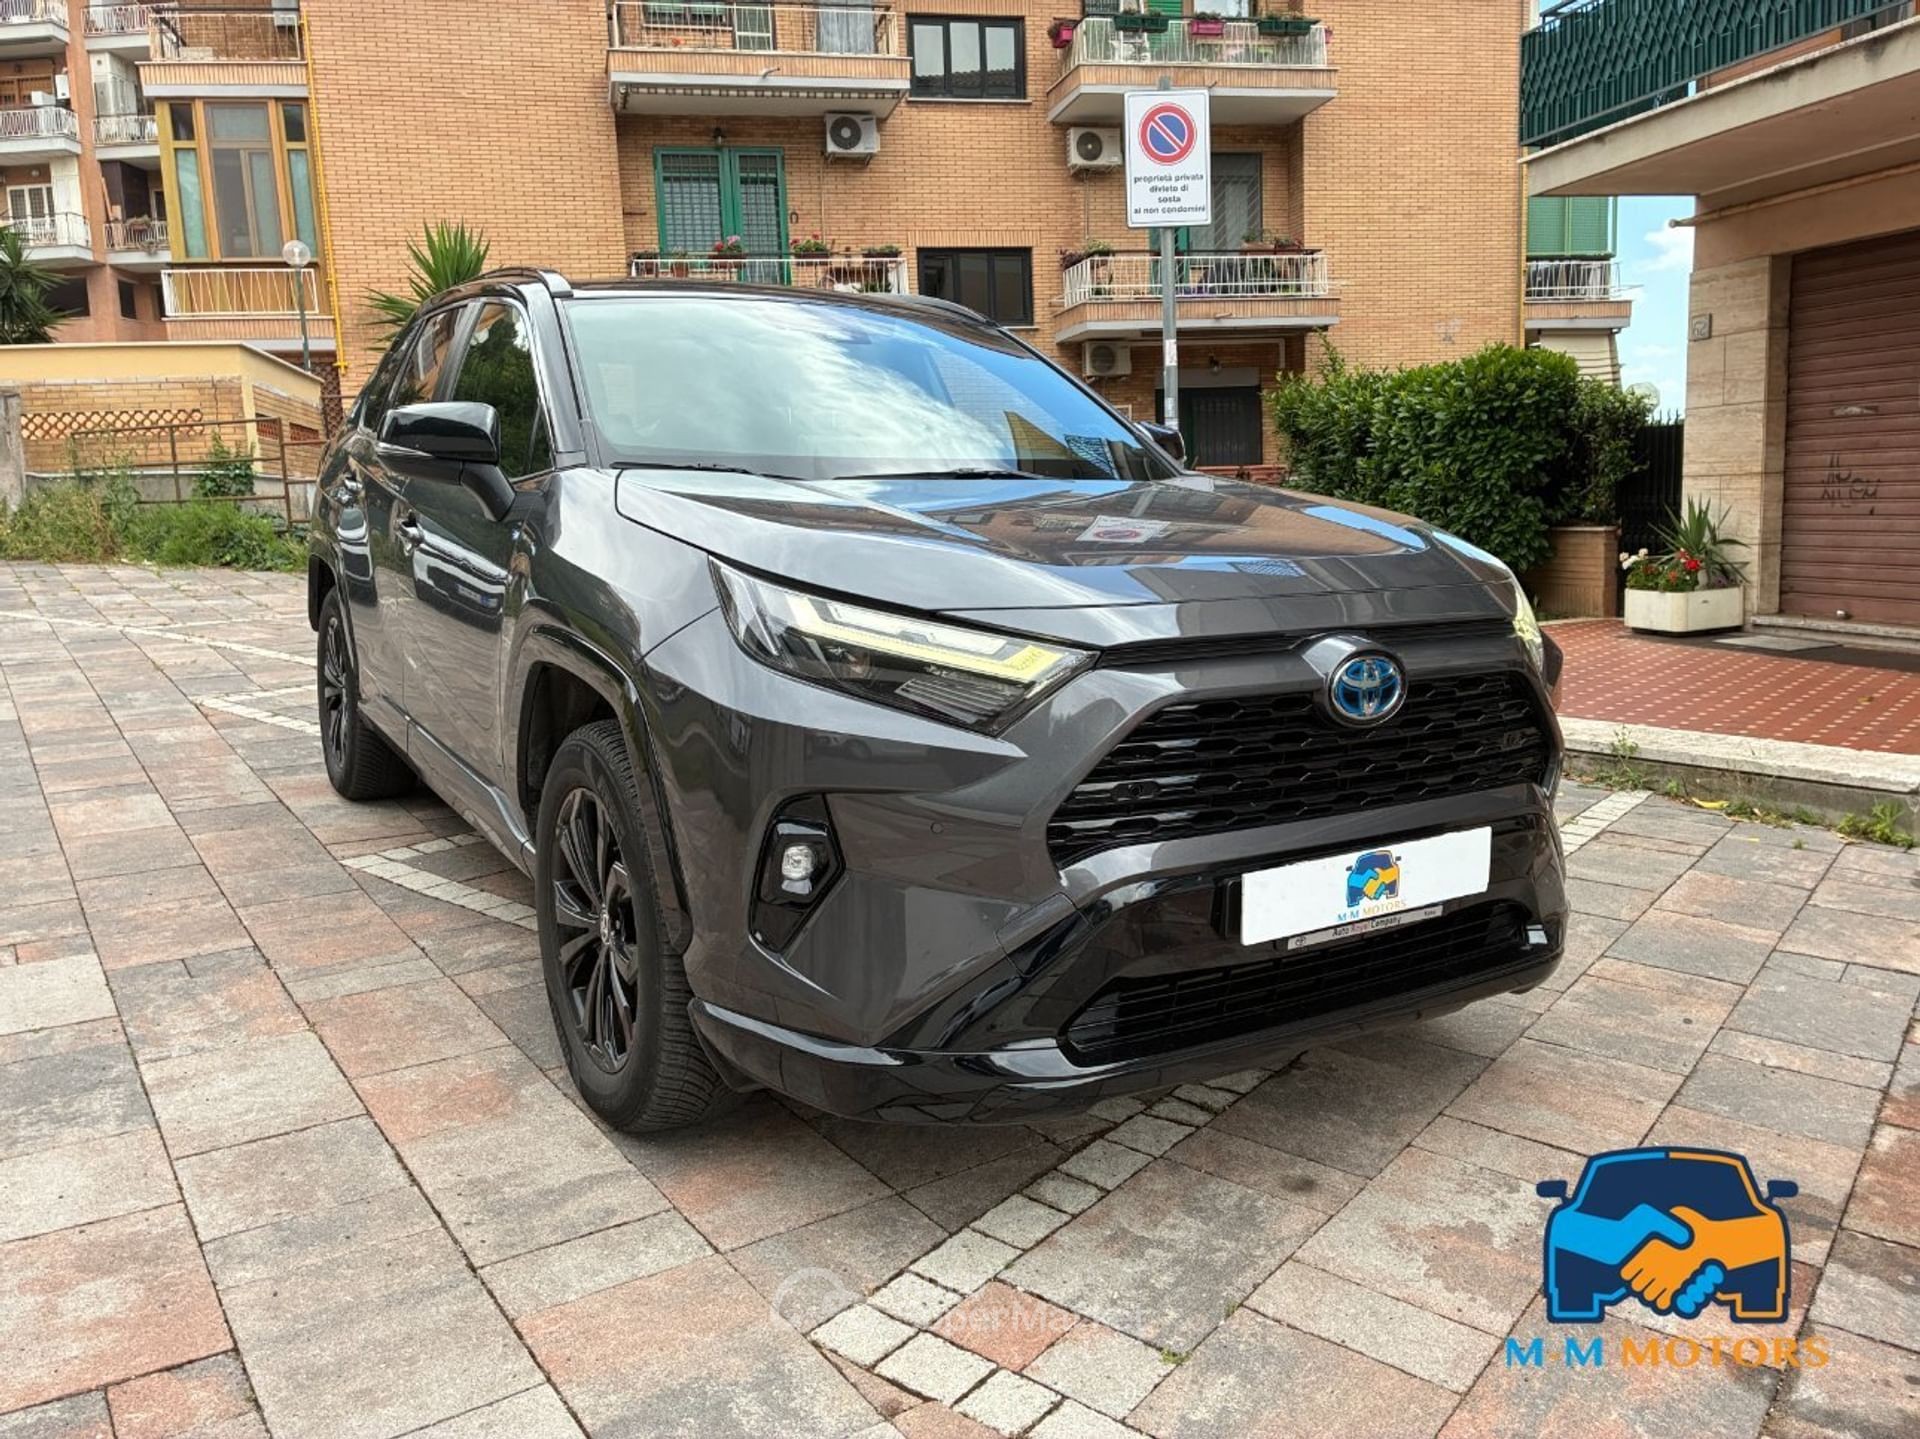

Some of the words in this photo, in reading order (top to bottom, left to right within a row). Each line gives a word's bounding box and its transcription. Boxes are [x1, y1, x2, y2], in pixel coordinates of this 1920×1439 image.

[1134, 174, 1172, 184] proprietà
[1175, 173, 1203, 183] privata
[1149, 185, 1178, 193] divieto
[1181, 184, 1189, 192] di
[1158, 195, 1181, 203] sosta
[1143, 206, 1159, 214] non
[1161, 205, 1206, 214] condomini
[1332, 927, 1350, 937] Auto
[1371, 915, 1402, 929] Company
